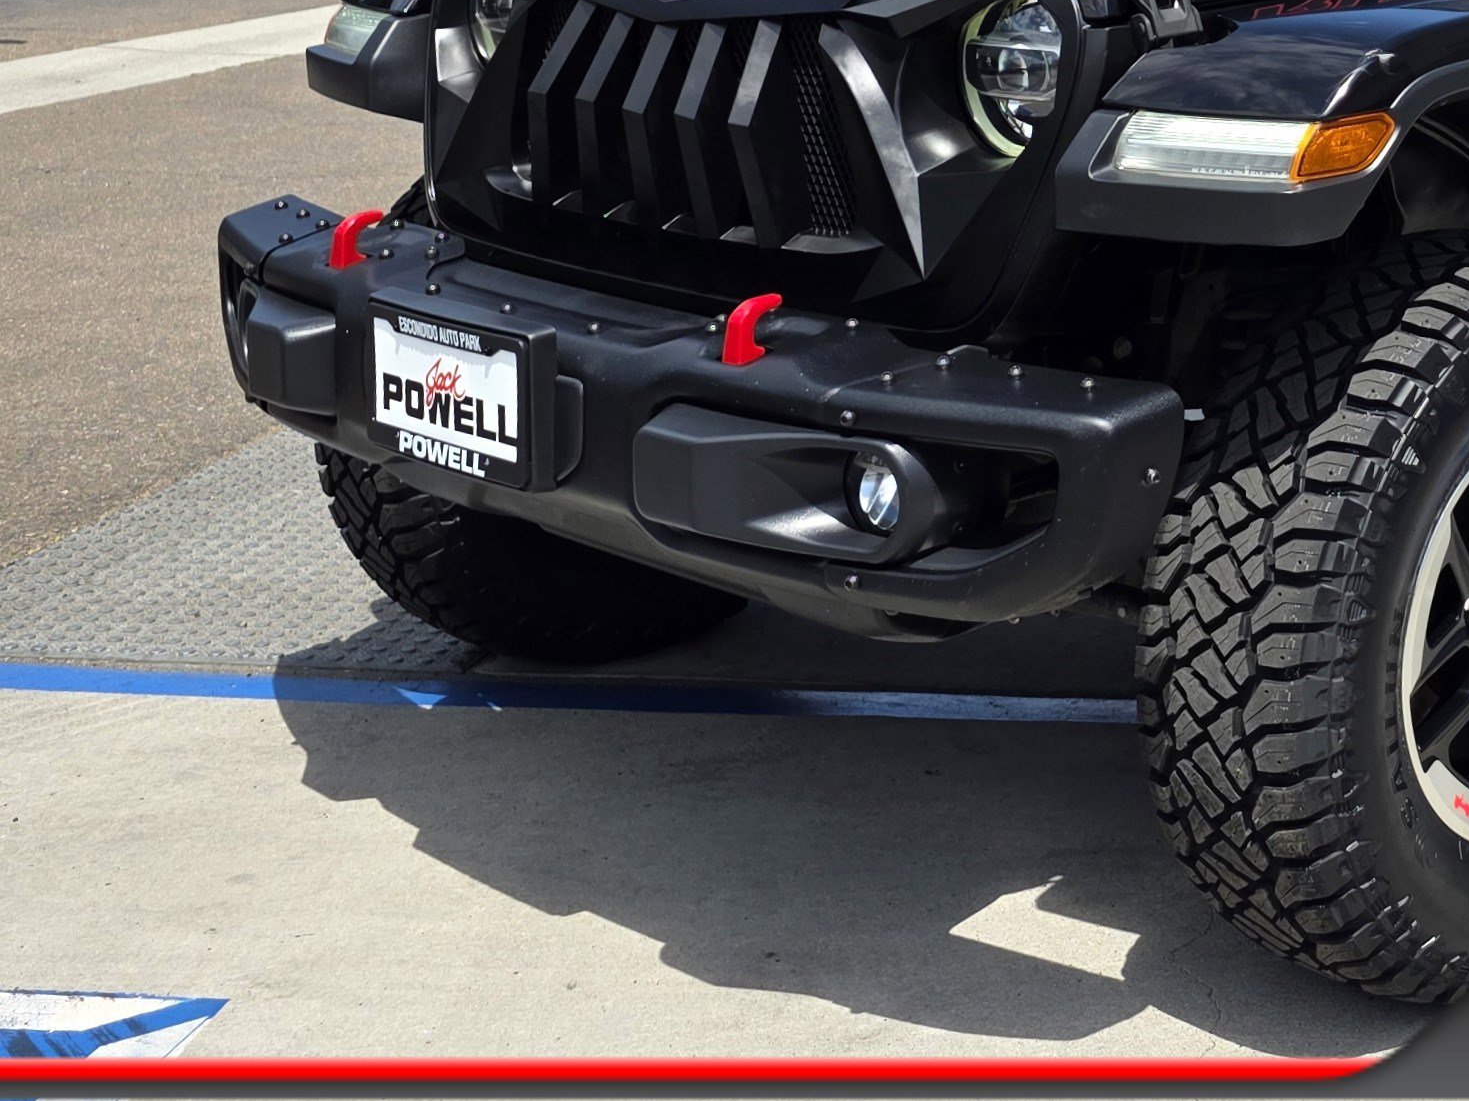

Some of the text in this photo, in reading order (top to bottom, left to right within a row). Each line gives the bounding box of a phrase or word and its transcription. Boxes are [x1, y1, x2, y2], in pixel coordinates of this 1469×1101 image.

[398, 316, 482, 352] ESCONDIDO AUTO PARK
[425, 358, 466, 407] Jack
[383, 372, 517, 447] POWELL
[399, 430, 487, 478] POWELL
